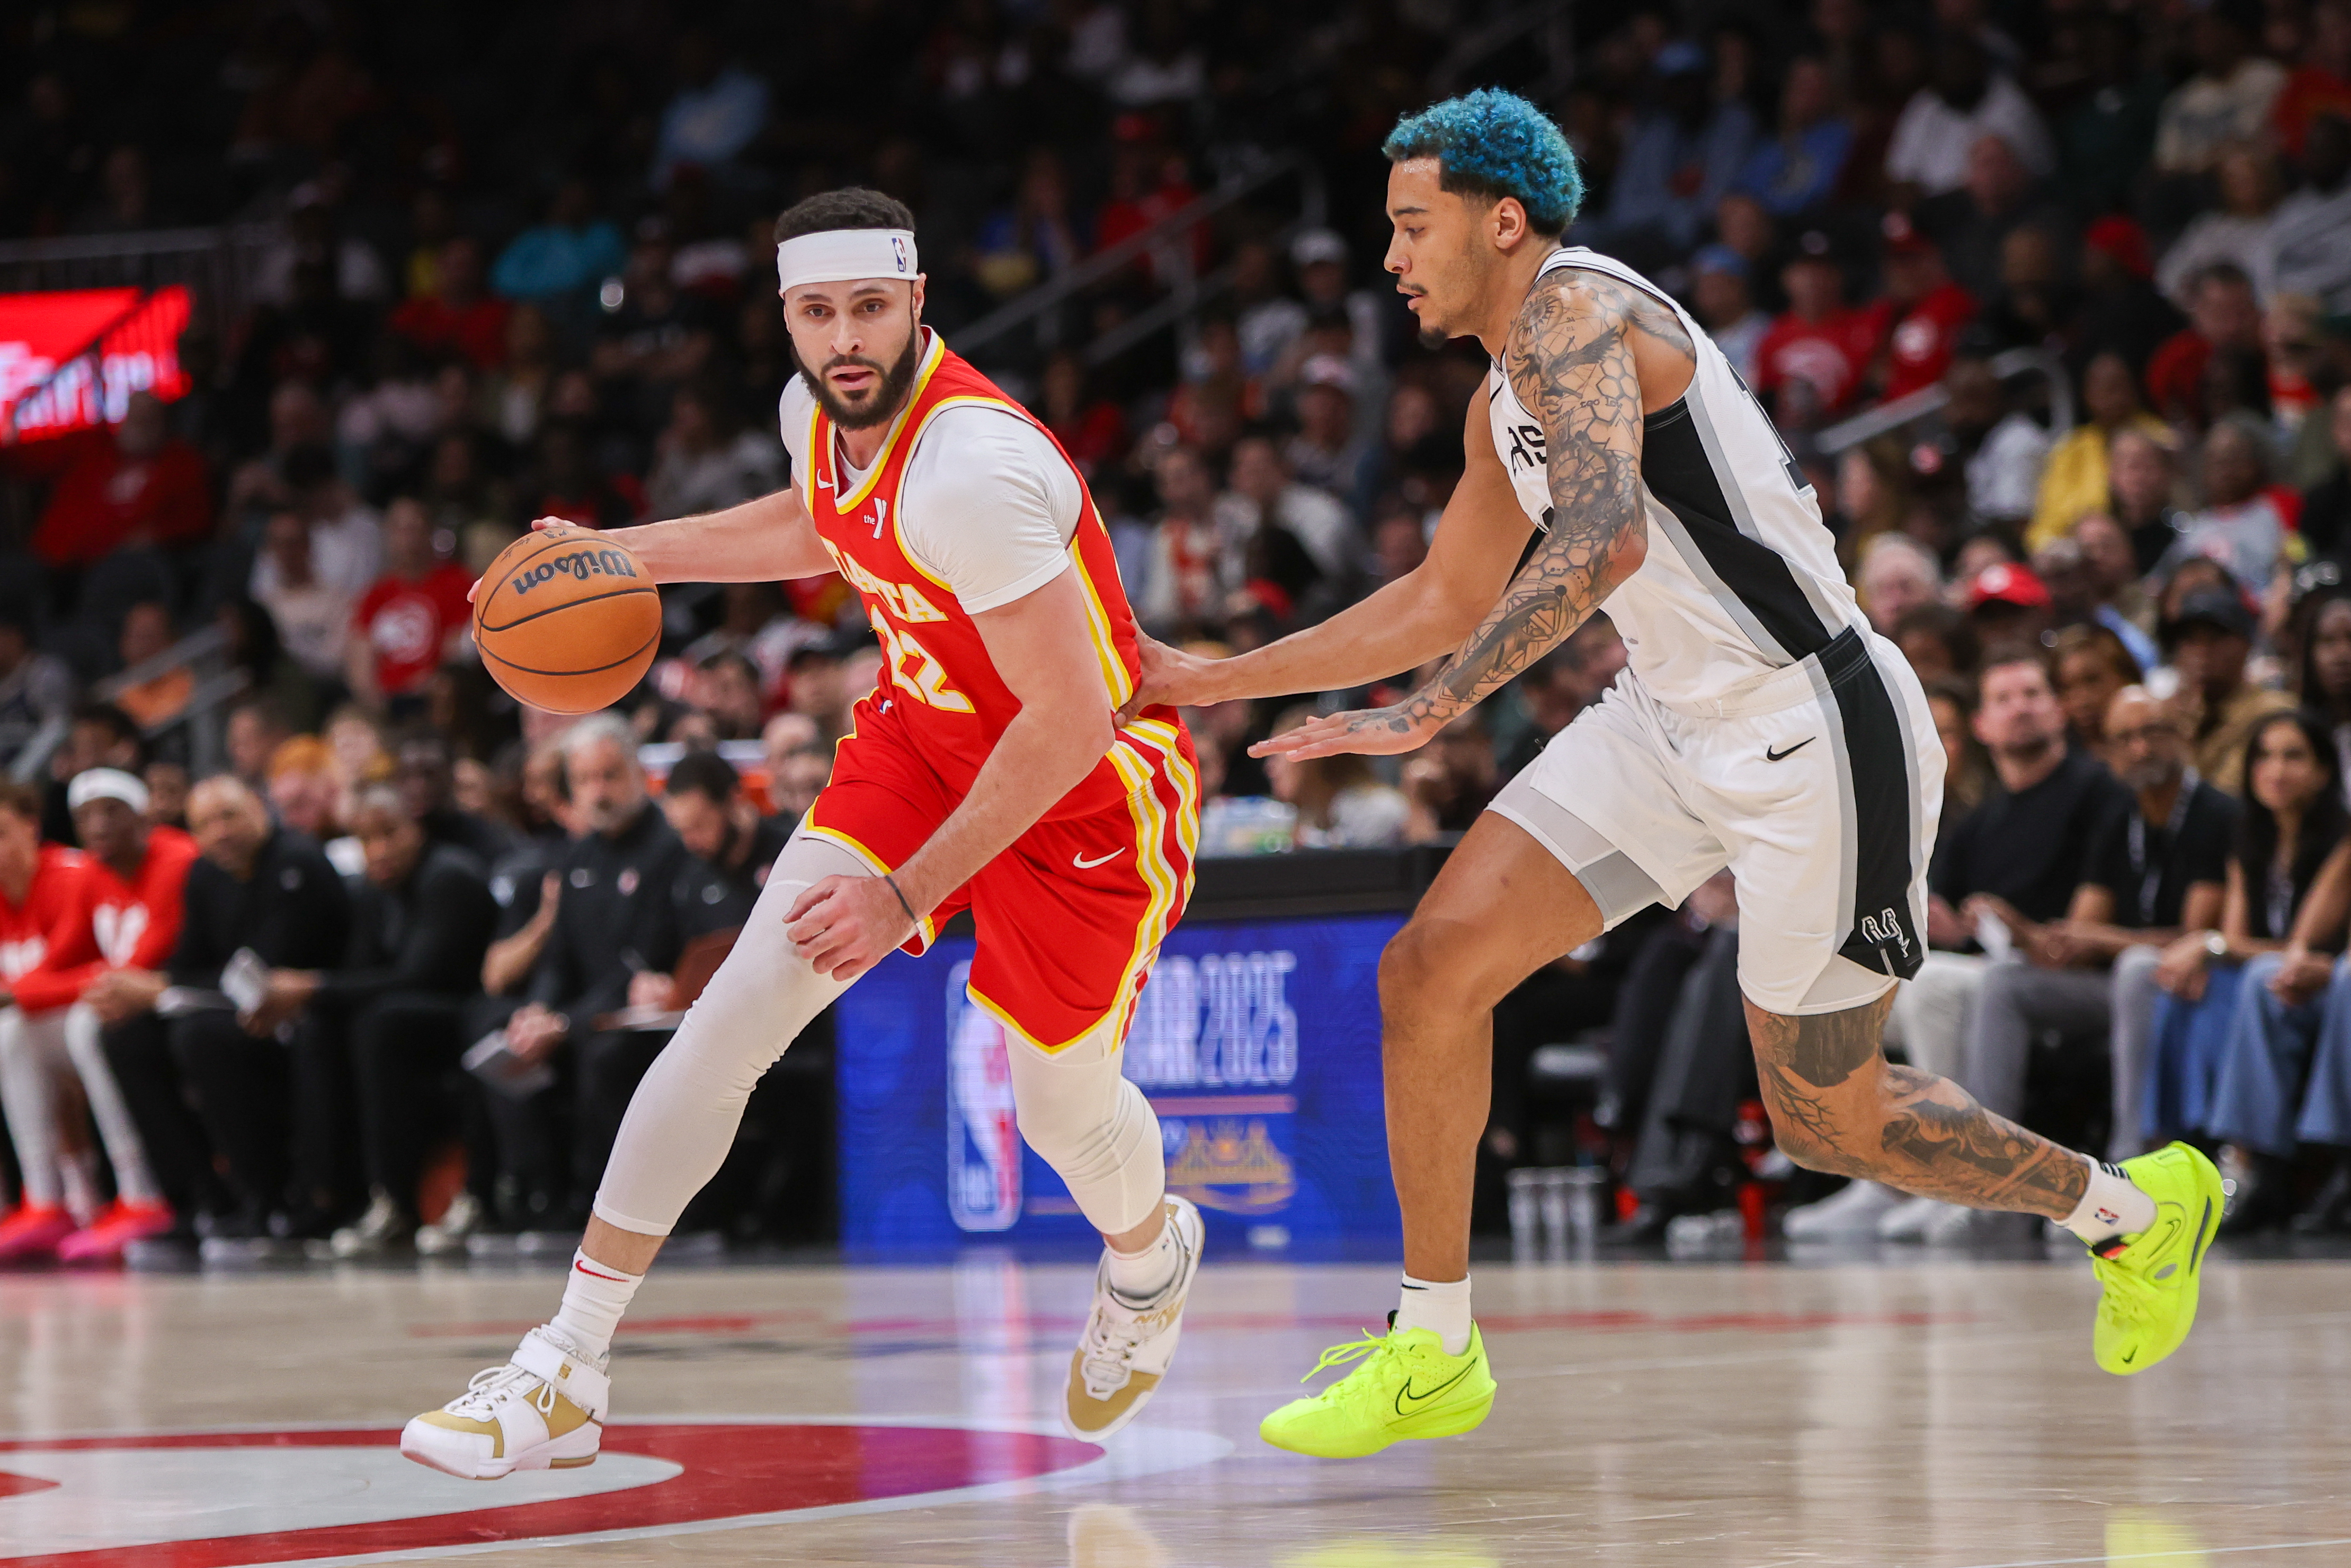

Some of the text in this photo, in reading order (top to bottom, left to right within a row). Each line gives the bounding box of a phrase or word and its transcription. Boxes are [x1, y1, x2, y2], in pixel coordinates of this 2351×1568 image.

[863, 514, 875, 525] the
[511, 549, 637, 595] Wilson
[870, 603, 976, 714] 22
